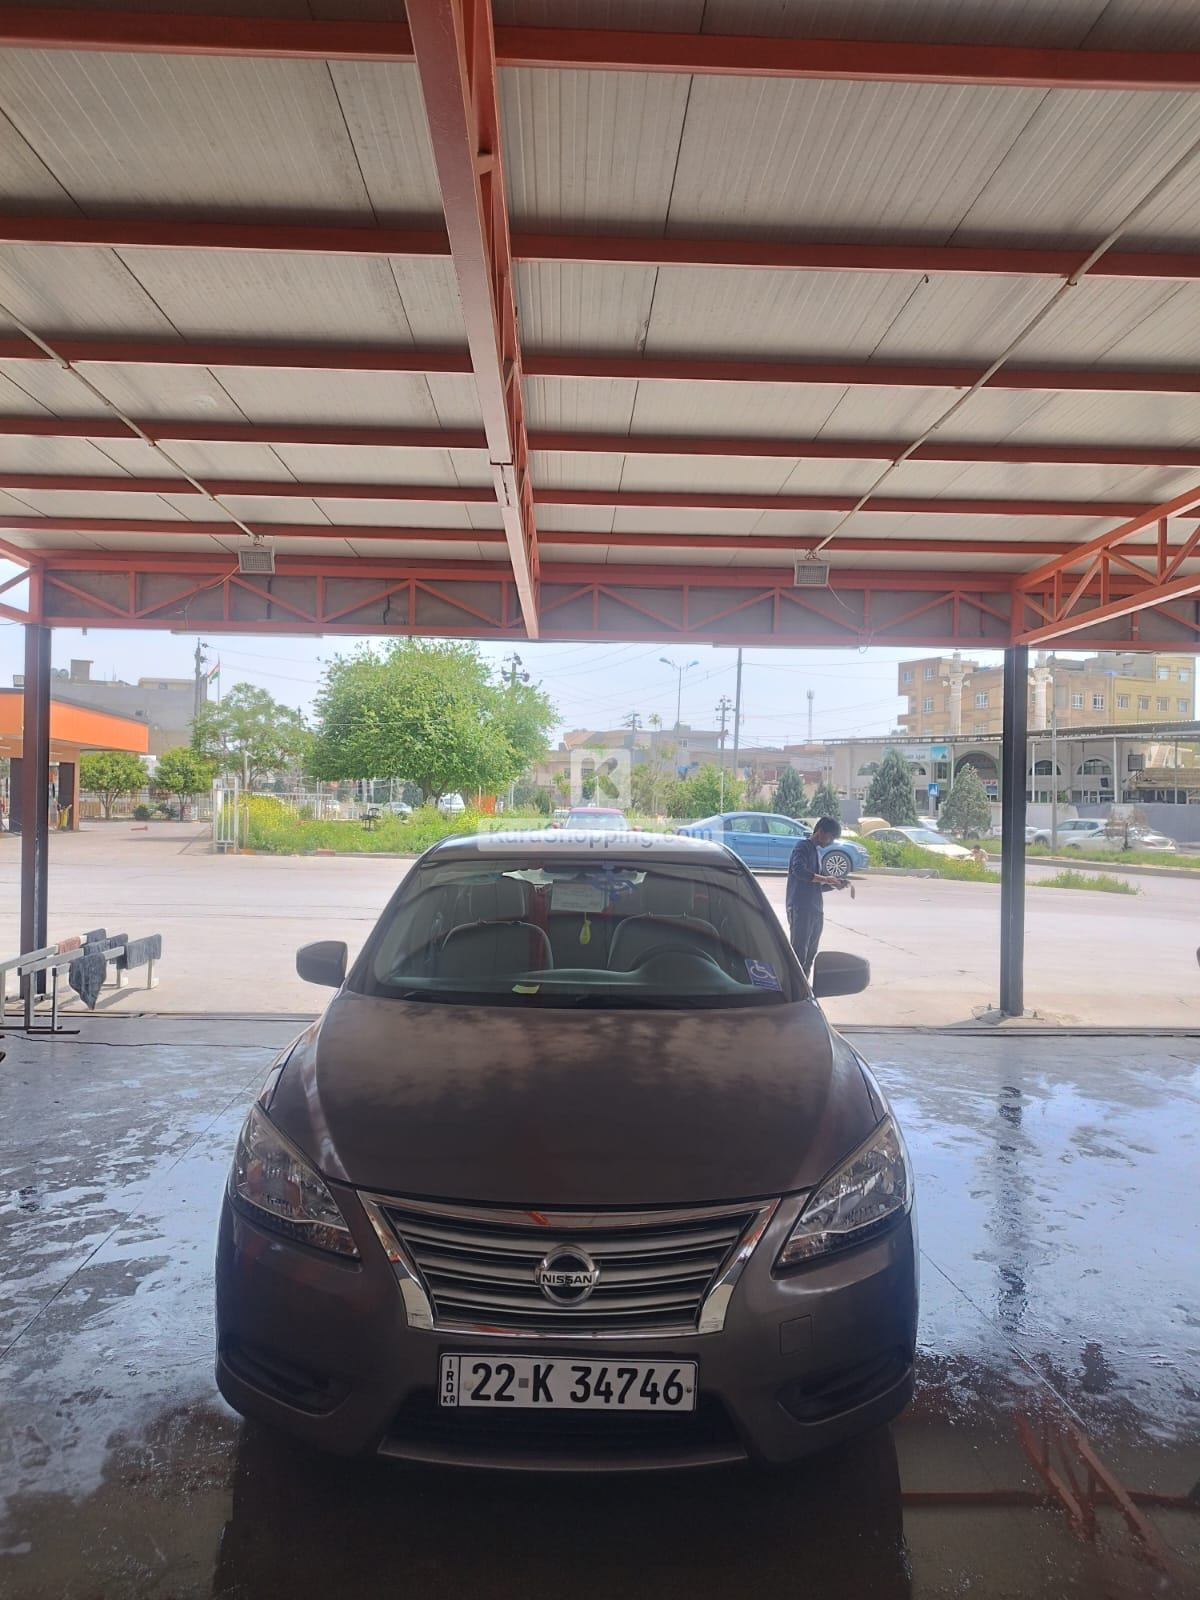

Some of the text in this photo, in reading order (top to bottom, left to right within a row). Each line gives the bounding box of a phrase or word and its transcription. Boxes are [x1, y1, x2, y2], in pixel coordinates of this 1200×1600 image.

[542, 1274, 593, 1285] NISSAN
[470, 1363, 684, 1405] 22 K 34746
[442, 1395, 456, 1404] KR
